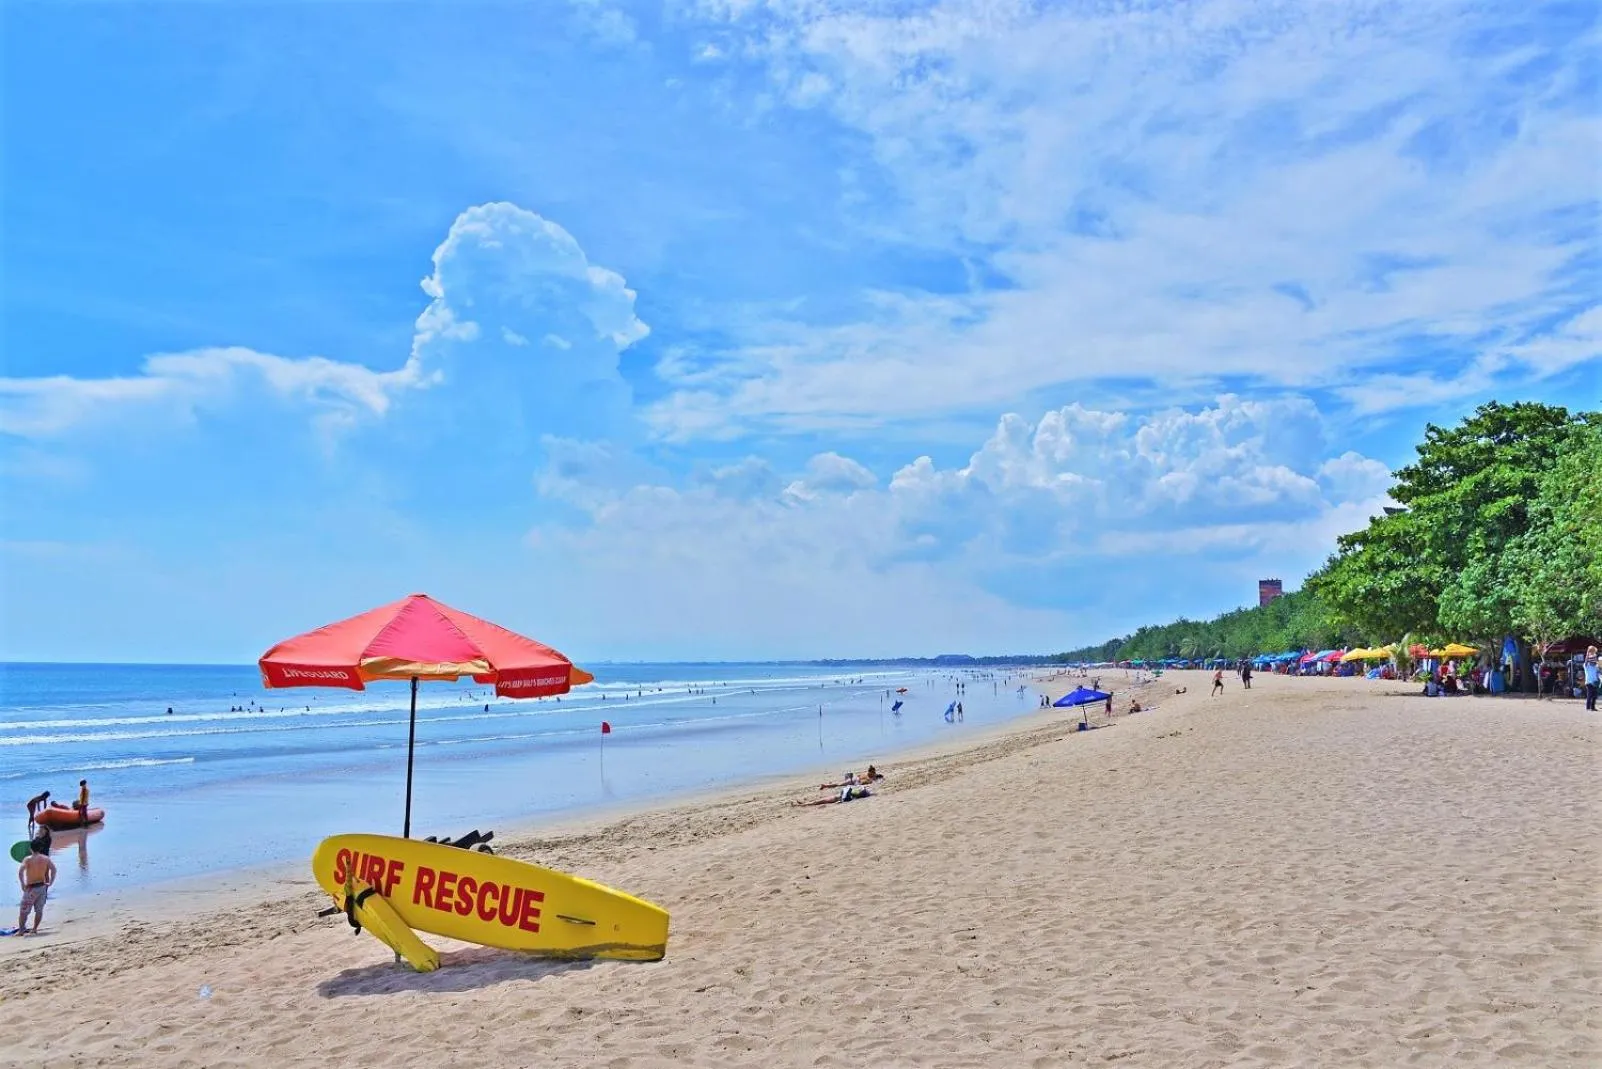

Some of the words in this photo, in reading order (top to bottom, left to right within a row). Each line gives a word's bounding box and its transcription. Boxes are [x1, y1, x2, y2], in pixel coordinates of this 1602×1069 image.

[281, 667, 349, 680] LIFEGUARD
[333, 847, 405, 898] SURF
[412, 865, 545, 933] RESCUE
